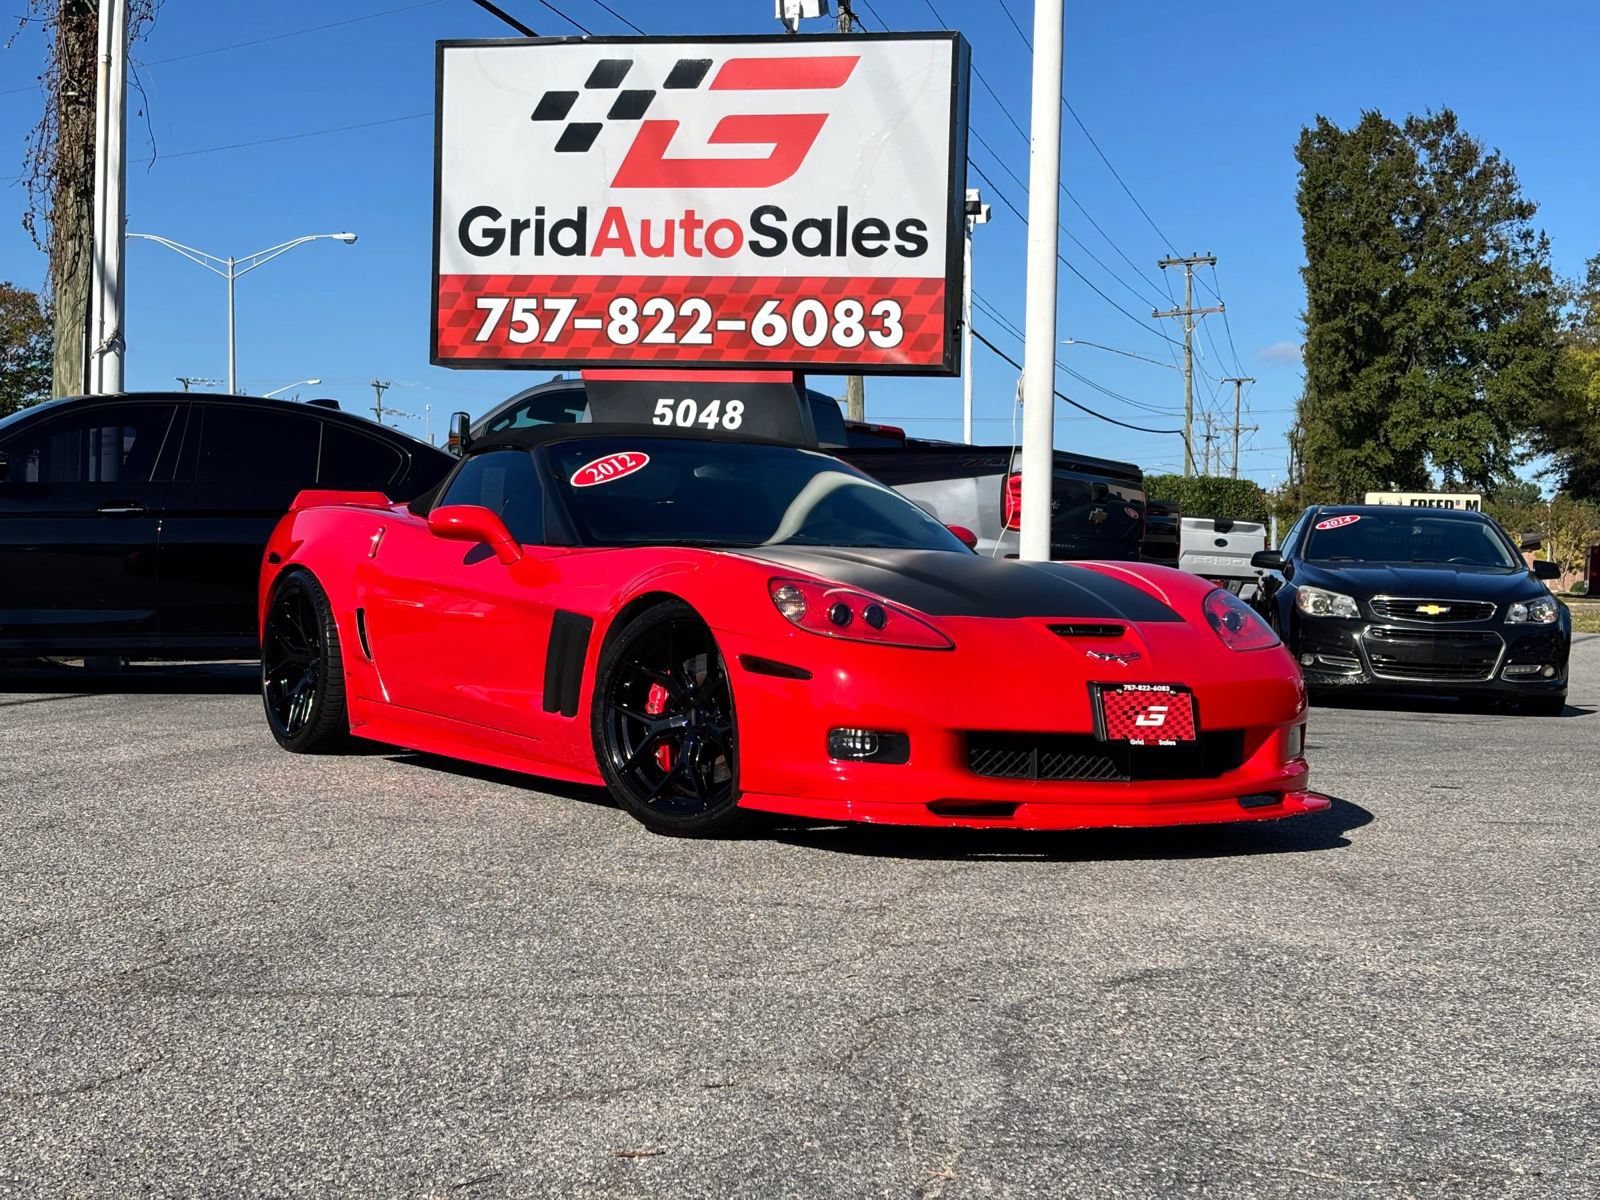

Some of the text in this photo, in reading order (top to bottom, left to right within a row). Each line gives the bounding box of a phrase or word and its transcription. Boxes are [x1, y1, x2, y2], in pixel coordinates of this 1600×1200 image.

[458, 205, 929, 258] GridAutoSales
[474, 296, 906, 349] 757-822-6083
[652, 398, 745, 430] 5048
[584, 453, 638, 482] 2012
[1123, 684, 1170, 692] 757-822-6083
